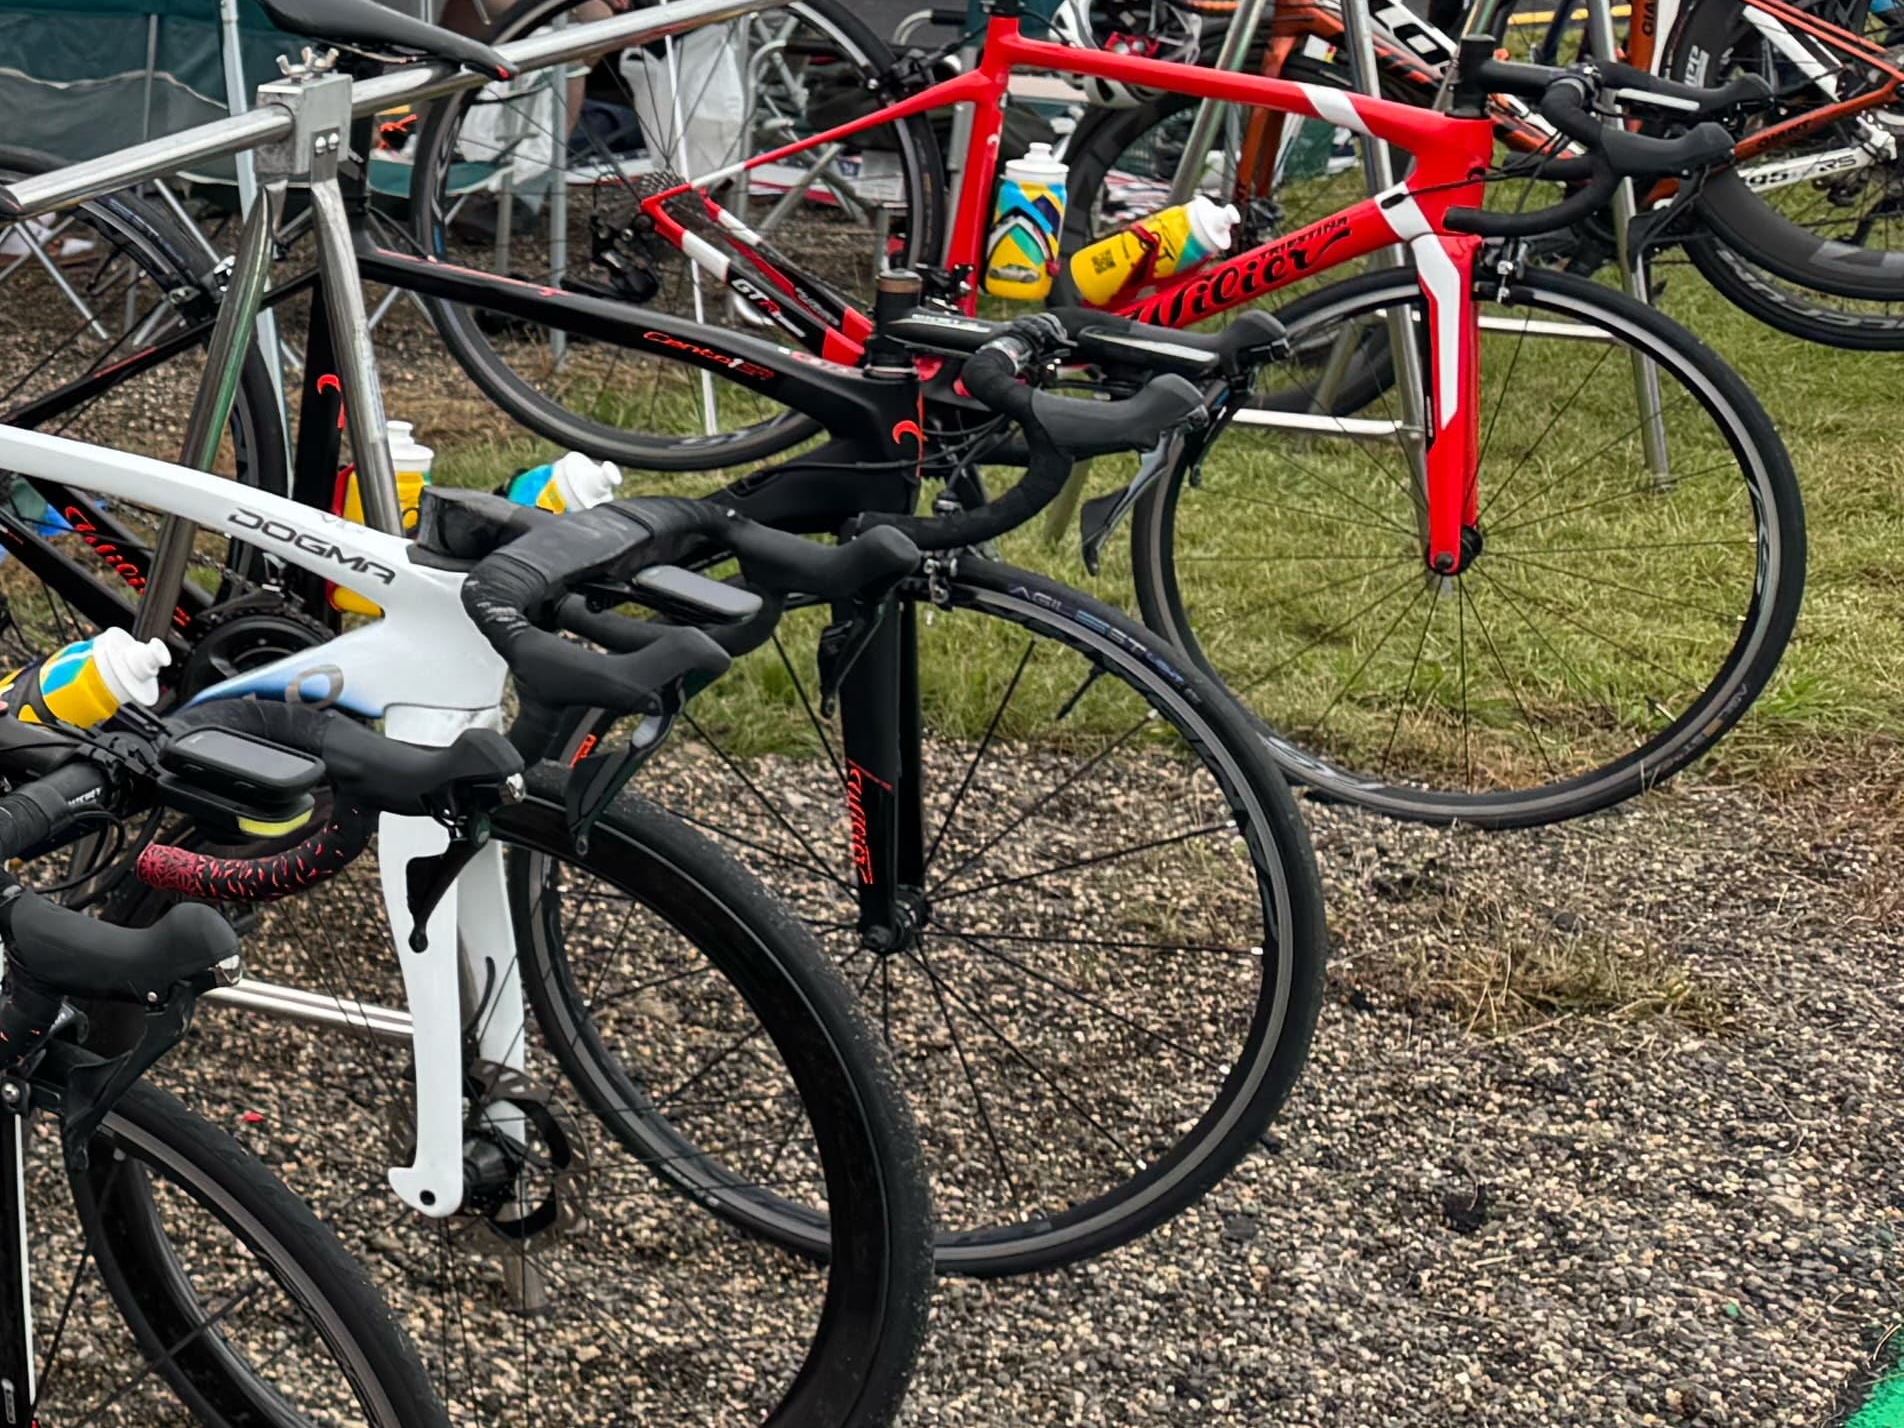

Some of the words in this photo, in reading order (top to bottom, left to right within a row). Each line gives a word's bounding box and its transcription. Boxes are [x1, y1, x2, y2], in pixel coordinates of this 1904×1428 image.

[1258, 215, 1348, 262] TRIESTINA
[1120, 227, 1351, 329] Wilier
[227, 508, 396, 586] DOGMA
